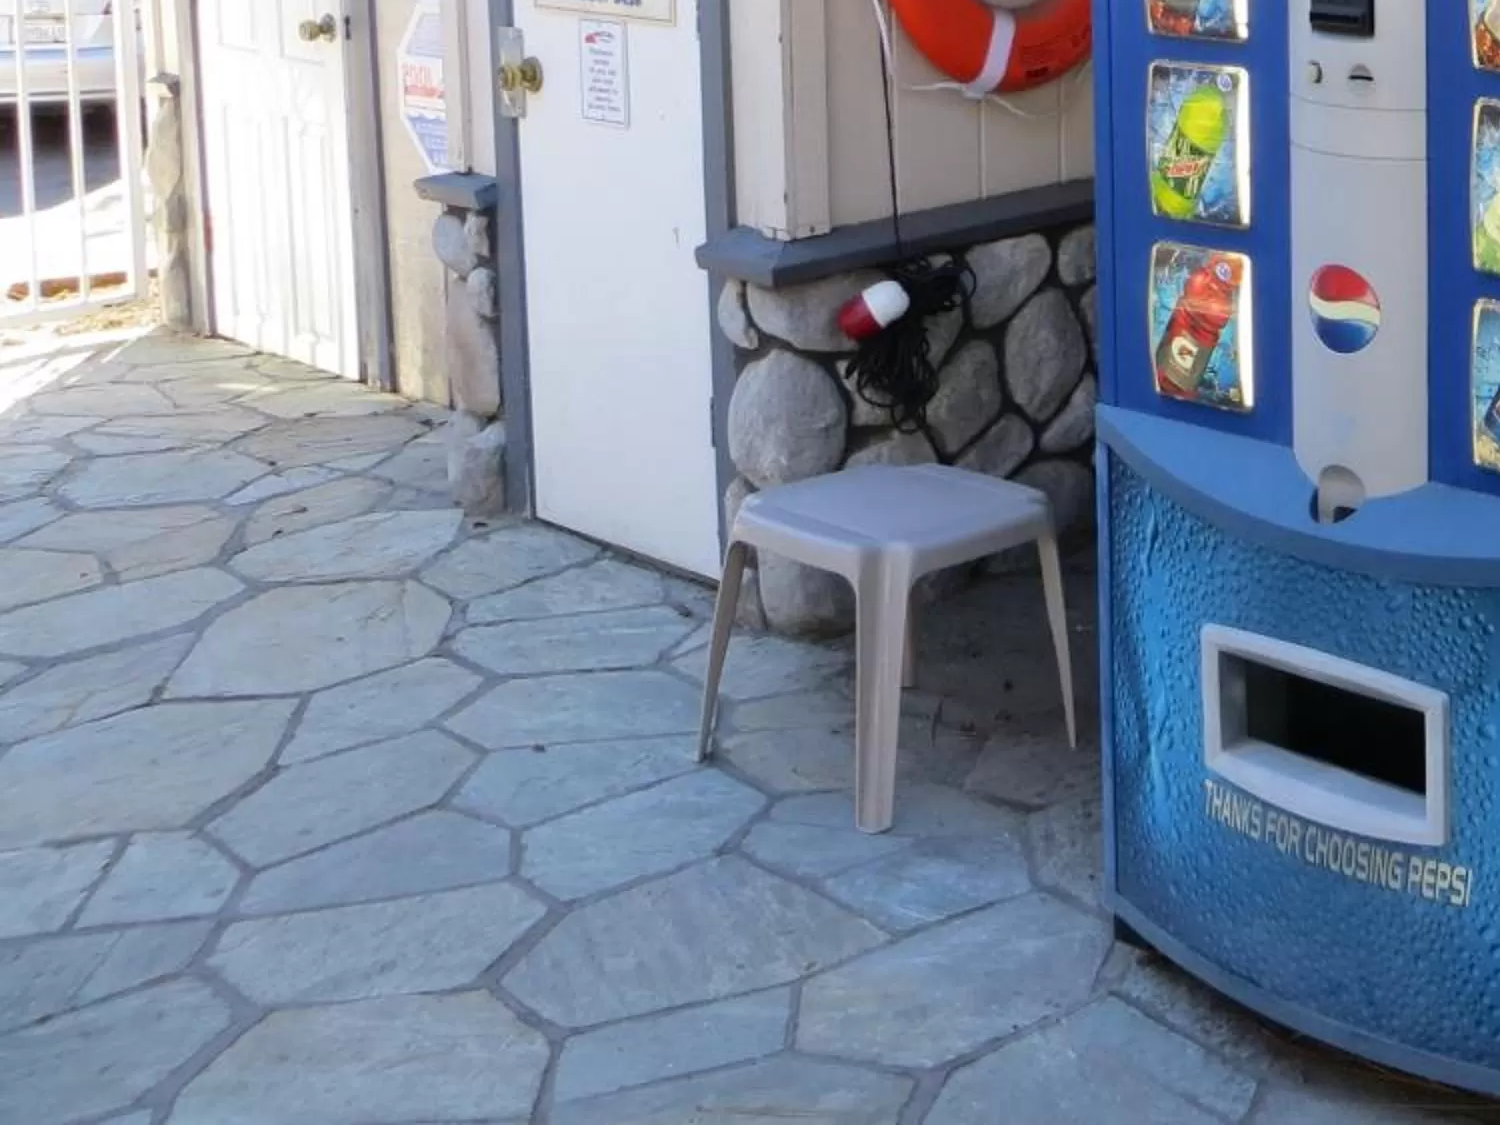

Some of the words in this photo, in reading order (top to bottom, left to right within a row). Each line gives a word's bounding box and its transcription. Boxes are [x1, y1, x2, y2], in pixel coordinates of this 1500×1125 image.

[1204, 779, 1262, 839] THANKS
[1265, 811, 1301, 857] FOR
[1304, 826, 1403, 890] CHOOSING
[1407, 856, 1473, 907] PEPSI
